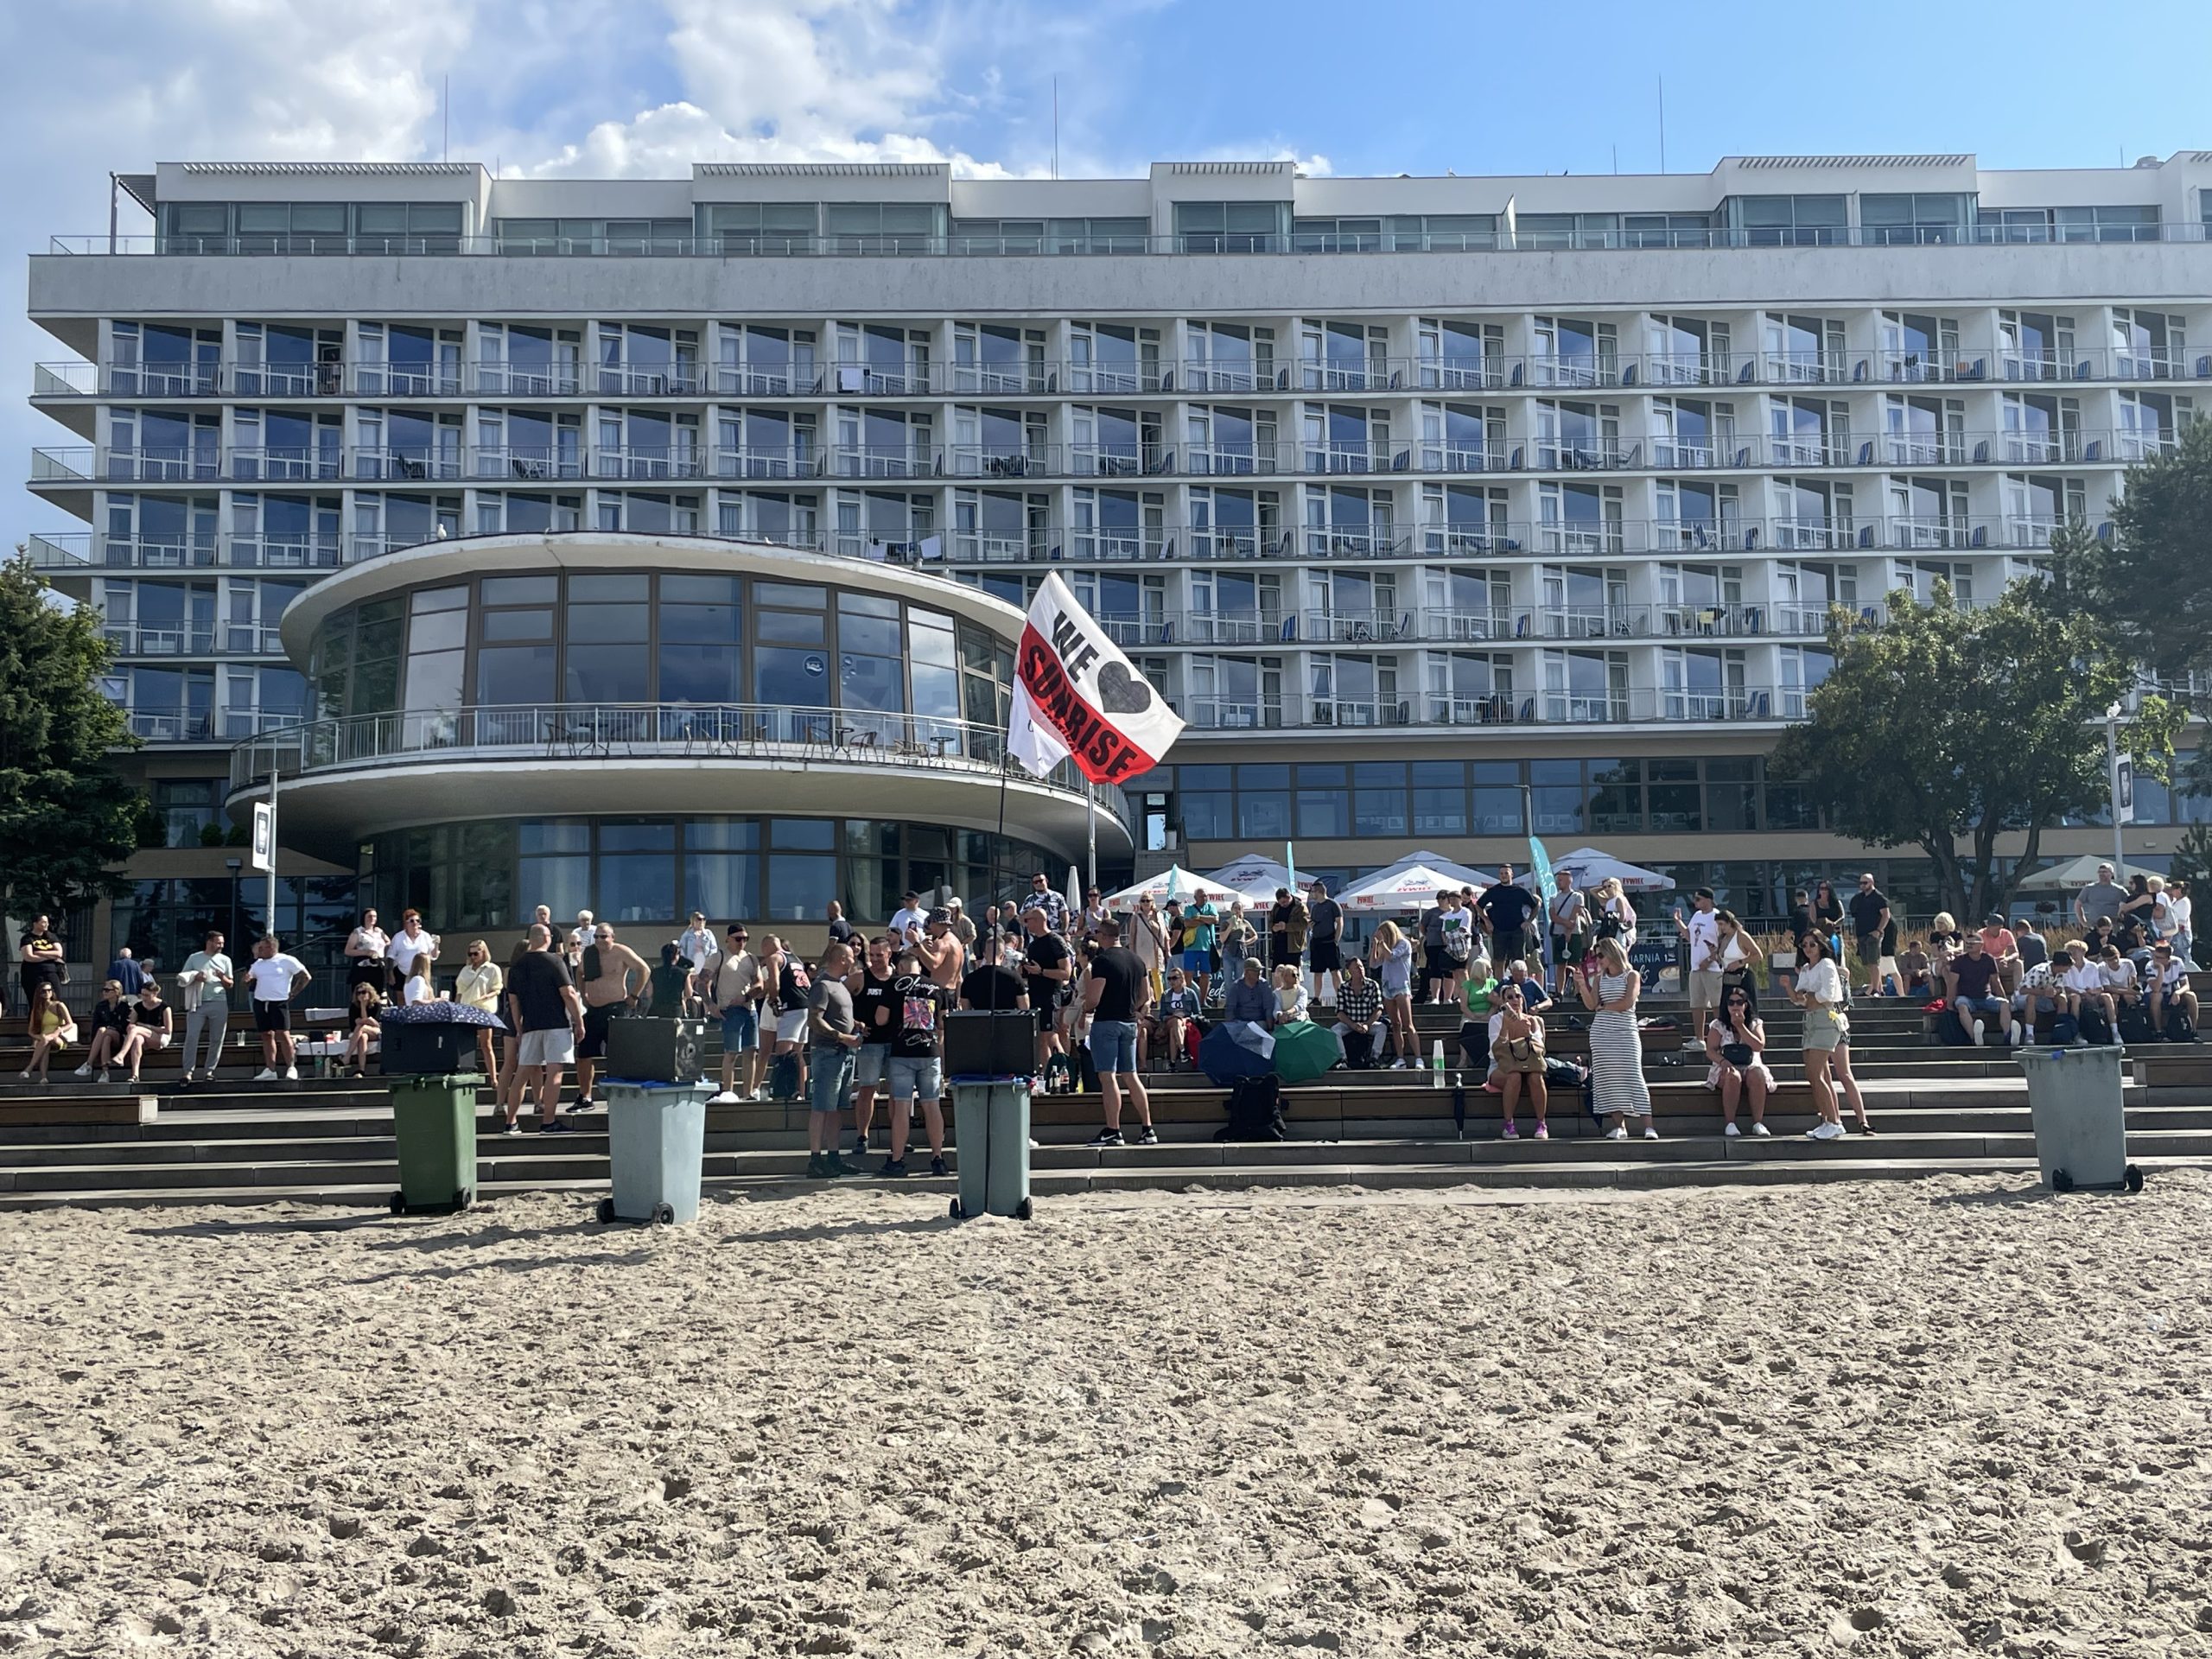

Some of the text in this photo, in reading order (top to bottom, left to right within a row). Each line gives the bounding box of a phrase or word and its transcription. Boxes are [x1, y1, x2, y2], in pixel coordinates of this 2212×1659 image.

[1052, 610, 1100, 683] WE
[1025, 645, 1138, 777] SUNRISE
[867, 988, 882, 996] JUST
